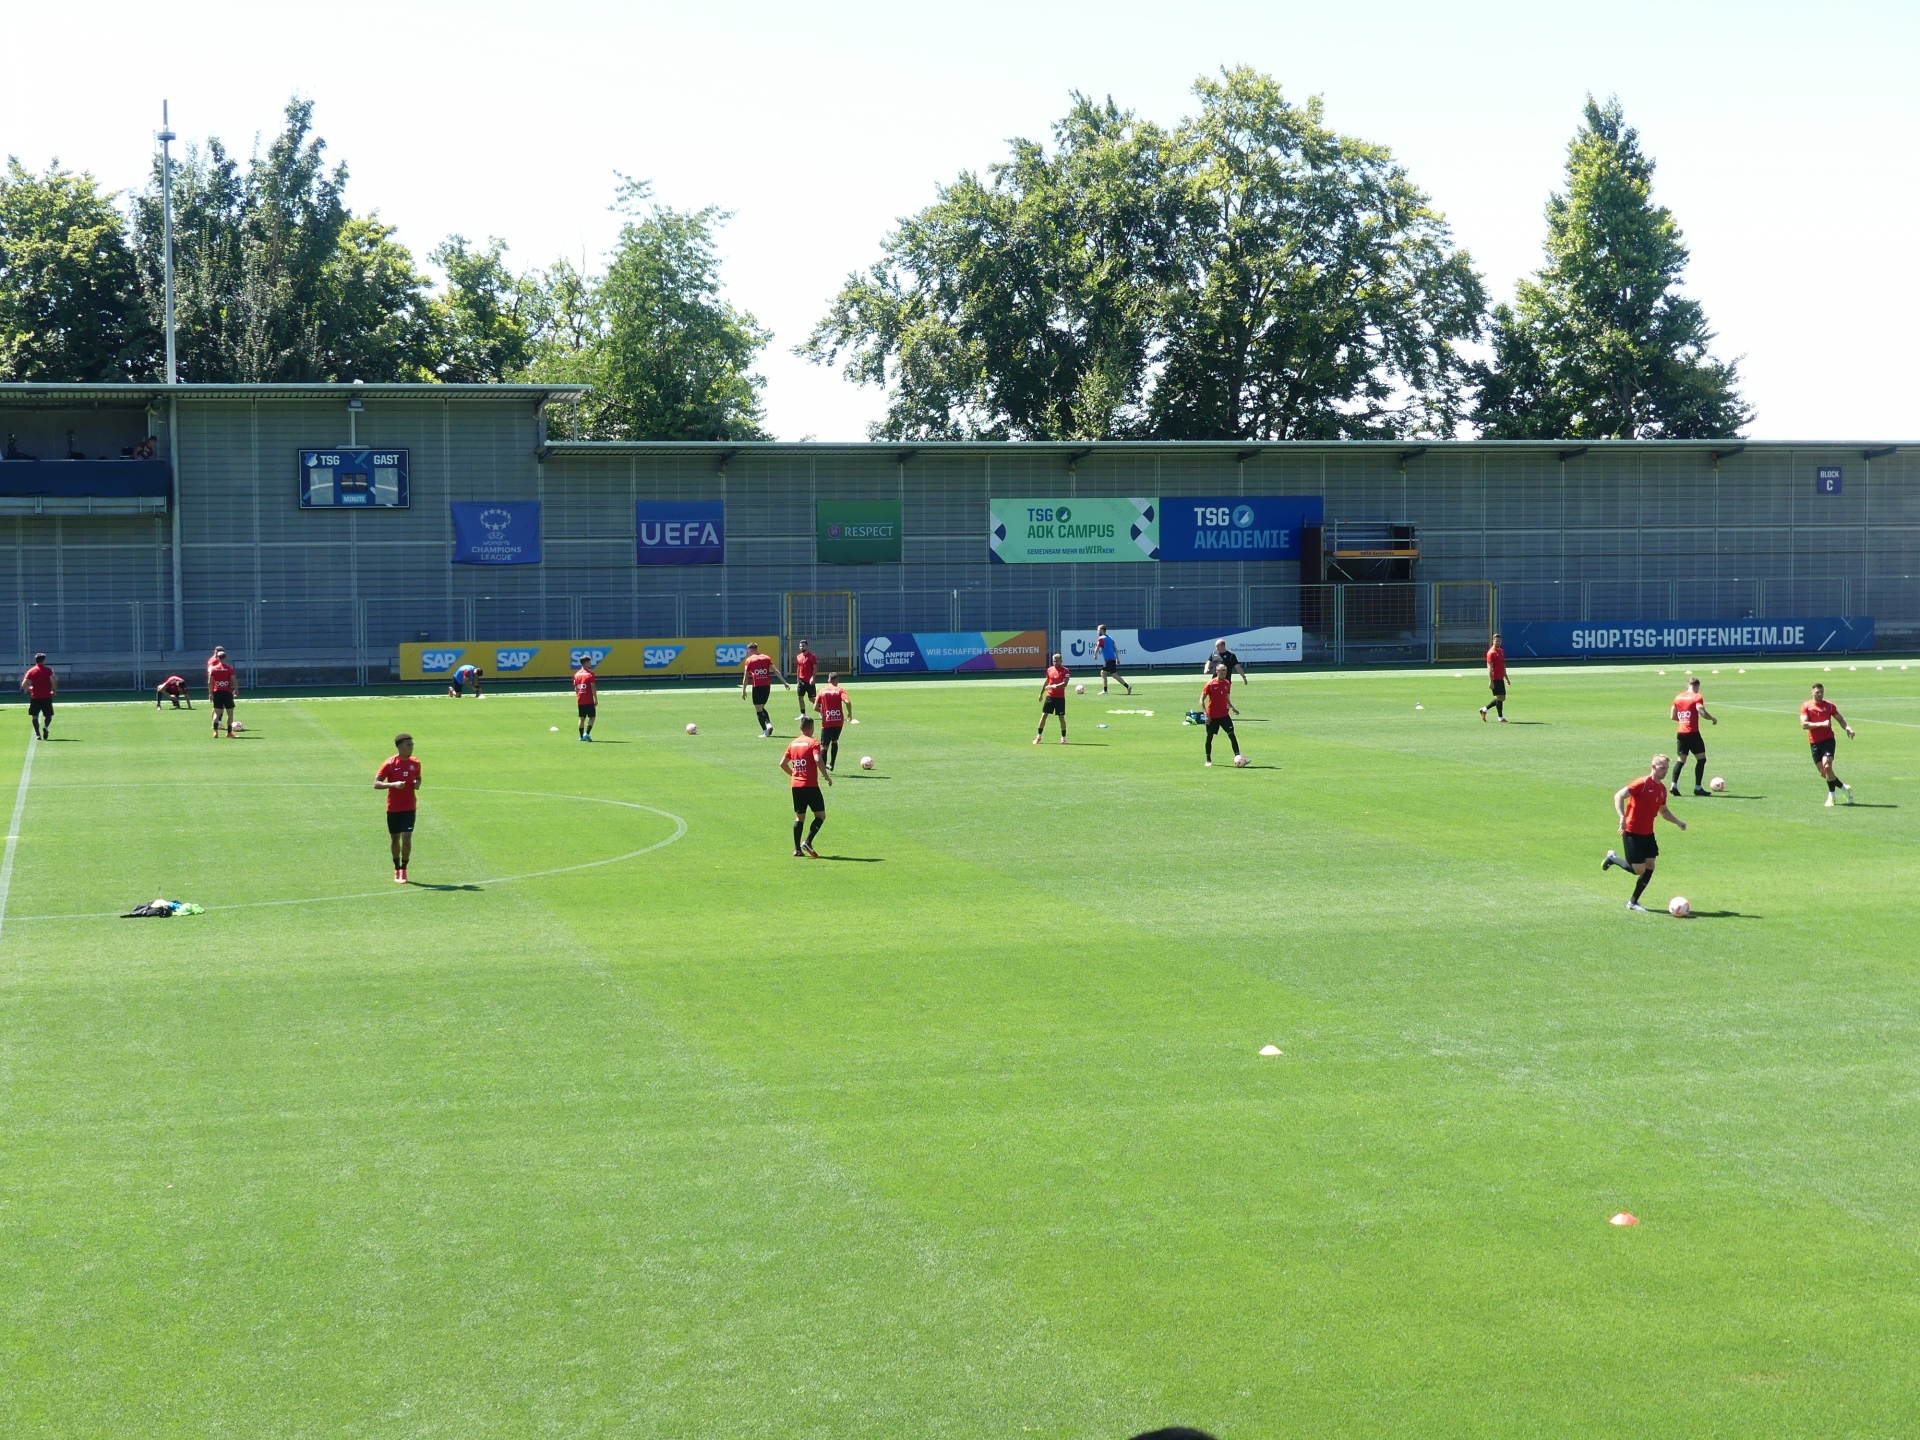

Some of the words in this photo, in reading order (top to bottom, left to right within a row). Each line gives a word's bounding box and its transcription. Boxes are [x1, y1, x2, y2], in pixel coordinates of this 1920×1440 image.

[320, 455, 340, 465] TSG
[374, 454, 399, 465] GAST
[1820, 470, 1840, 478] BLOCK
[1826, 479, 1833, 491] C
[1027, 508, 1053, 522] TSG
[1194, 507, 1230, 526] TSG
[641, 522, 719, 545] UEFA
[844, 526, 893, 537] RESPECT
[1027, 525, 1054, 539] AOK
[1058, 524, 1115, 538] CAMPUS
[1194, 530, 1290, 549] AKADEMIE
[1571, 626, 1804, 649] SHOP.TSG-HOFFENHEIM.DE
[643, 649, 677, 664] SAP
[715, 648, 748, 663] SAP
[926, 648, 941, 656] WIR
[943, 647, 982, 656] SCHAFFEN
[984, 646, 1040, 655] PERSPEKTIVEN
[422, 653, 456, 669] SAP
[497, 652, 531, 667] SAP
[885, 657, 910, 665] LEBEN
